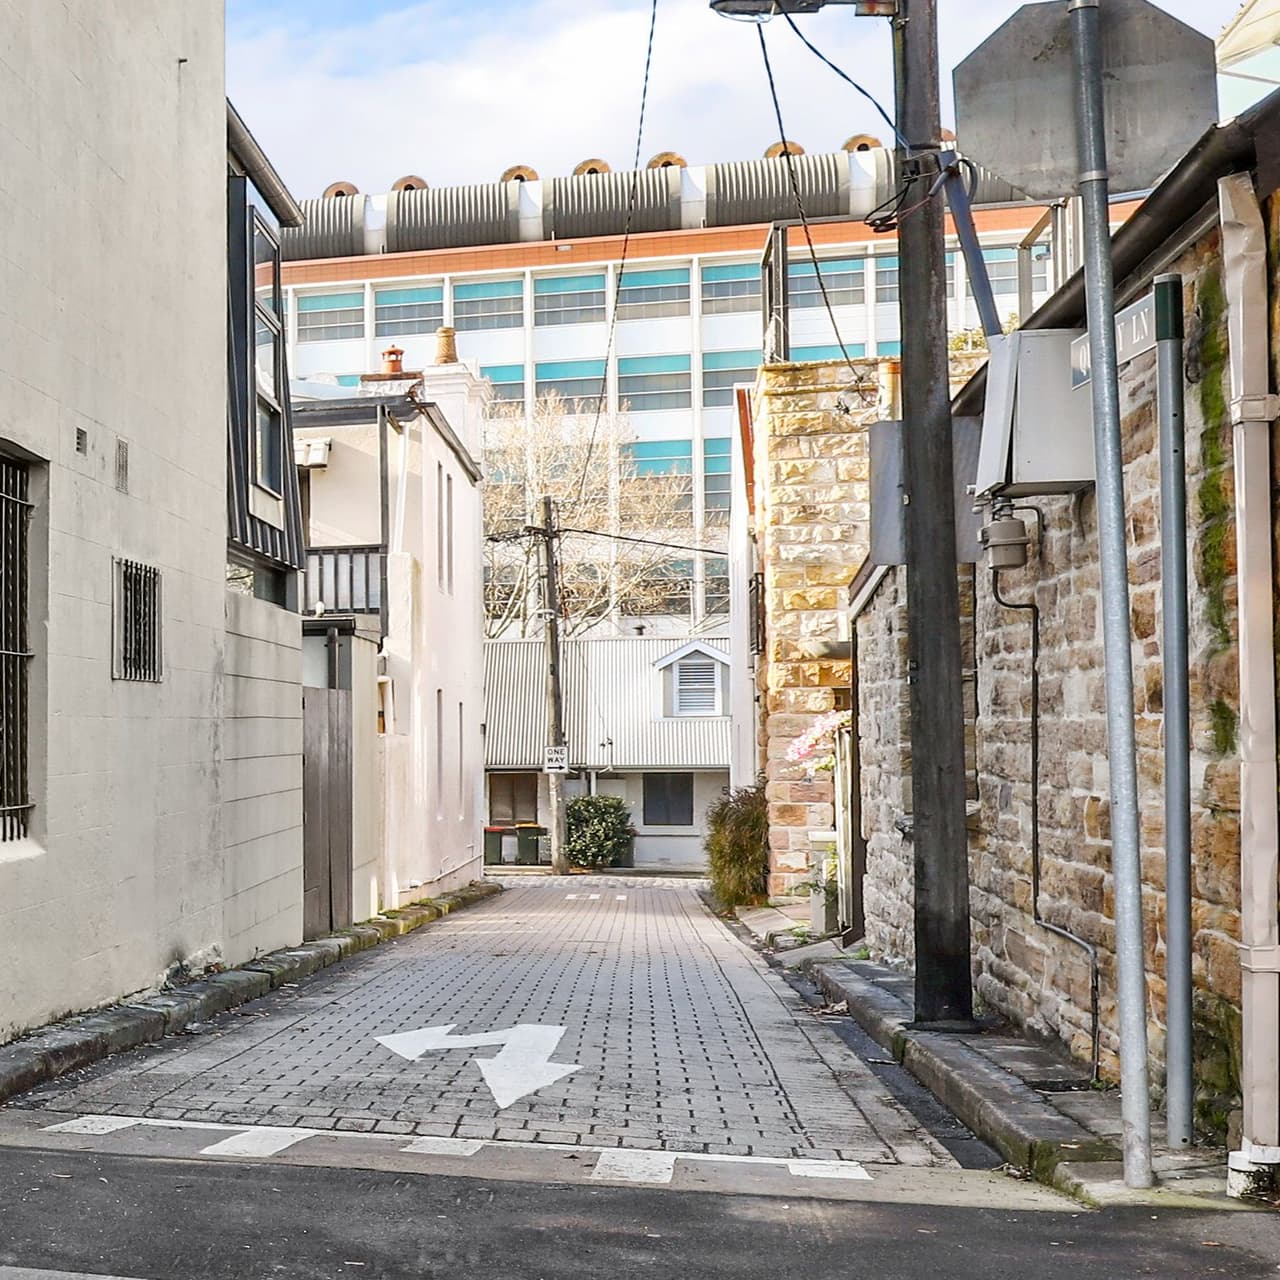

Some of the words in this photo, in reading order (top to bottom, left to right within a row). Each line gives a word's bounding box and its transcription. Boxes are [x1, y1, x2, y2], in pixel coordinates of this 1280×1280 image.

[1132, 308, 1150, 345] LN
[547, 748, 565, 756] ONE
[547, 756, 565, 764] WAY
